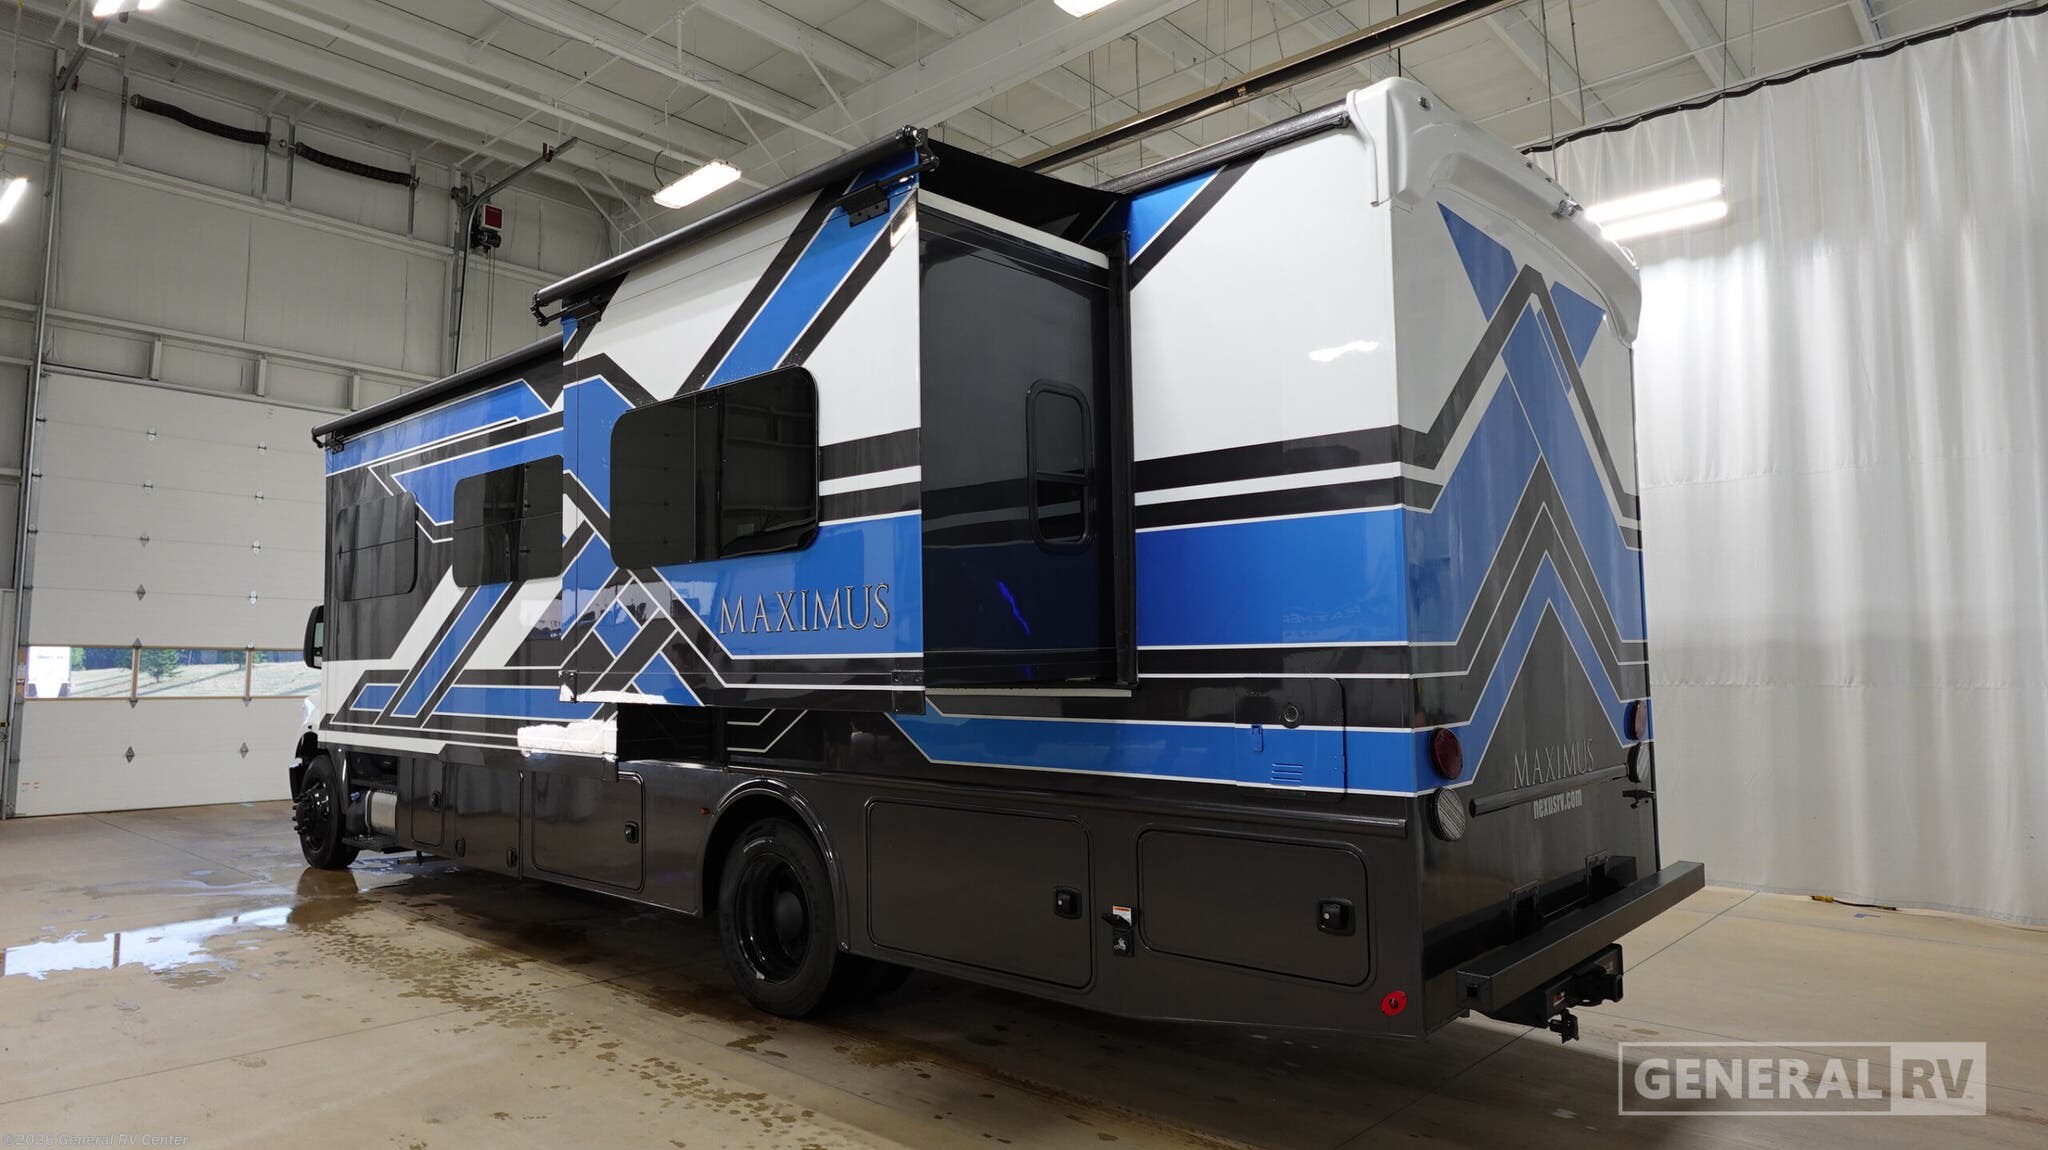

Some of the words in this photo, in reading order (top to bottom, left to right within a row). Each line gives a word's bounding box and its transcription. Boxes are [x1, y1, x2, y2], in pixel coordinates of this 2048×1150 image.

[719, 583, 890, 634] MAXIMUS
[1513, 738, 1594, 789] MAXIMUS
[1533, 789, 1583, 819] nexusrv.com
